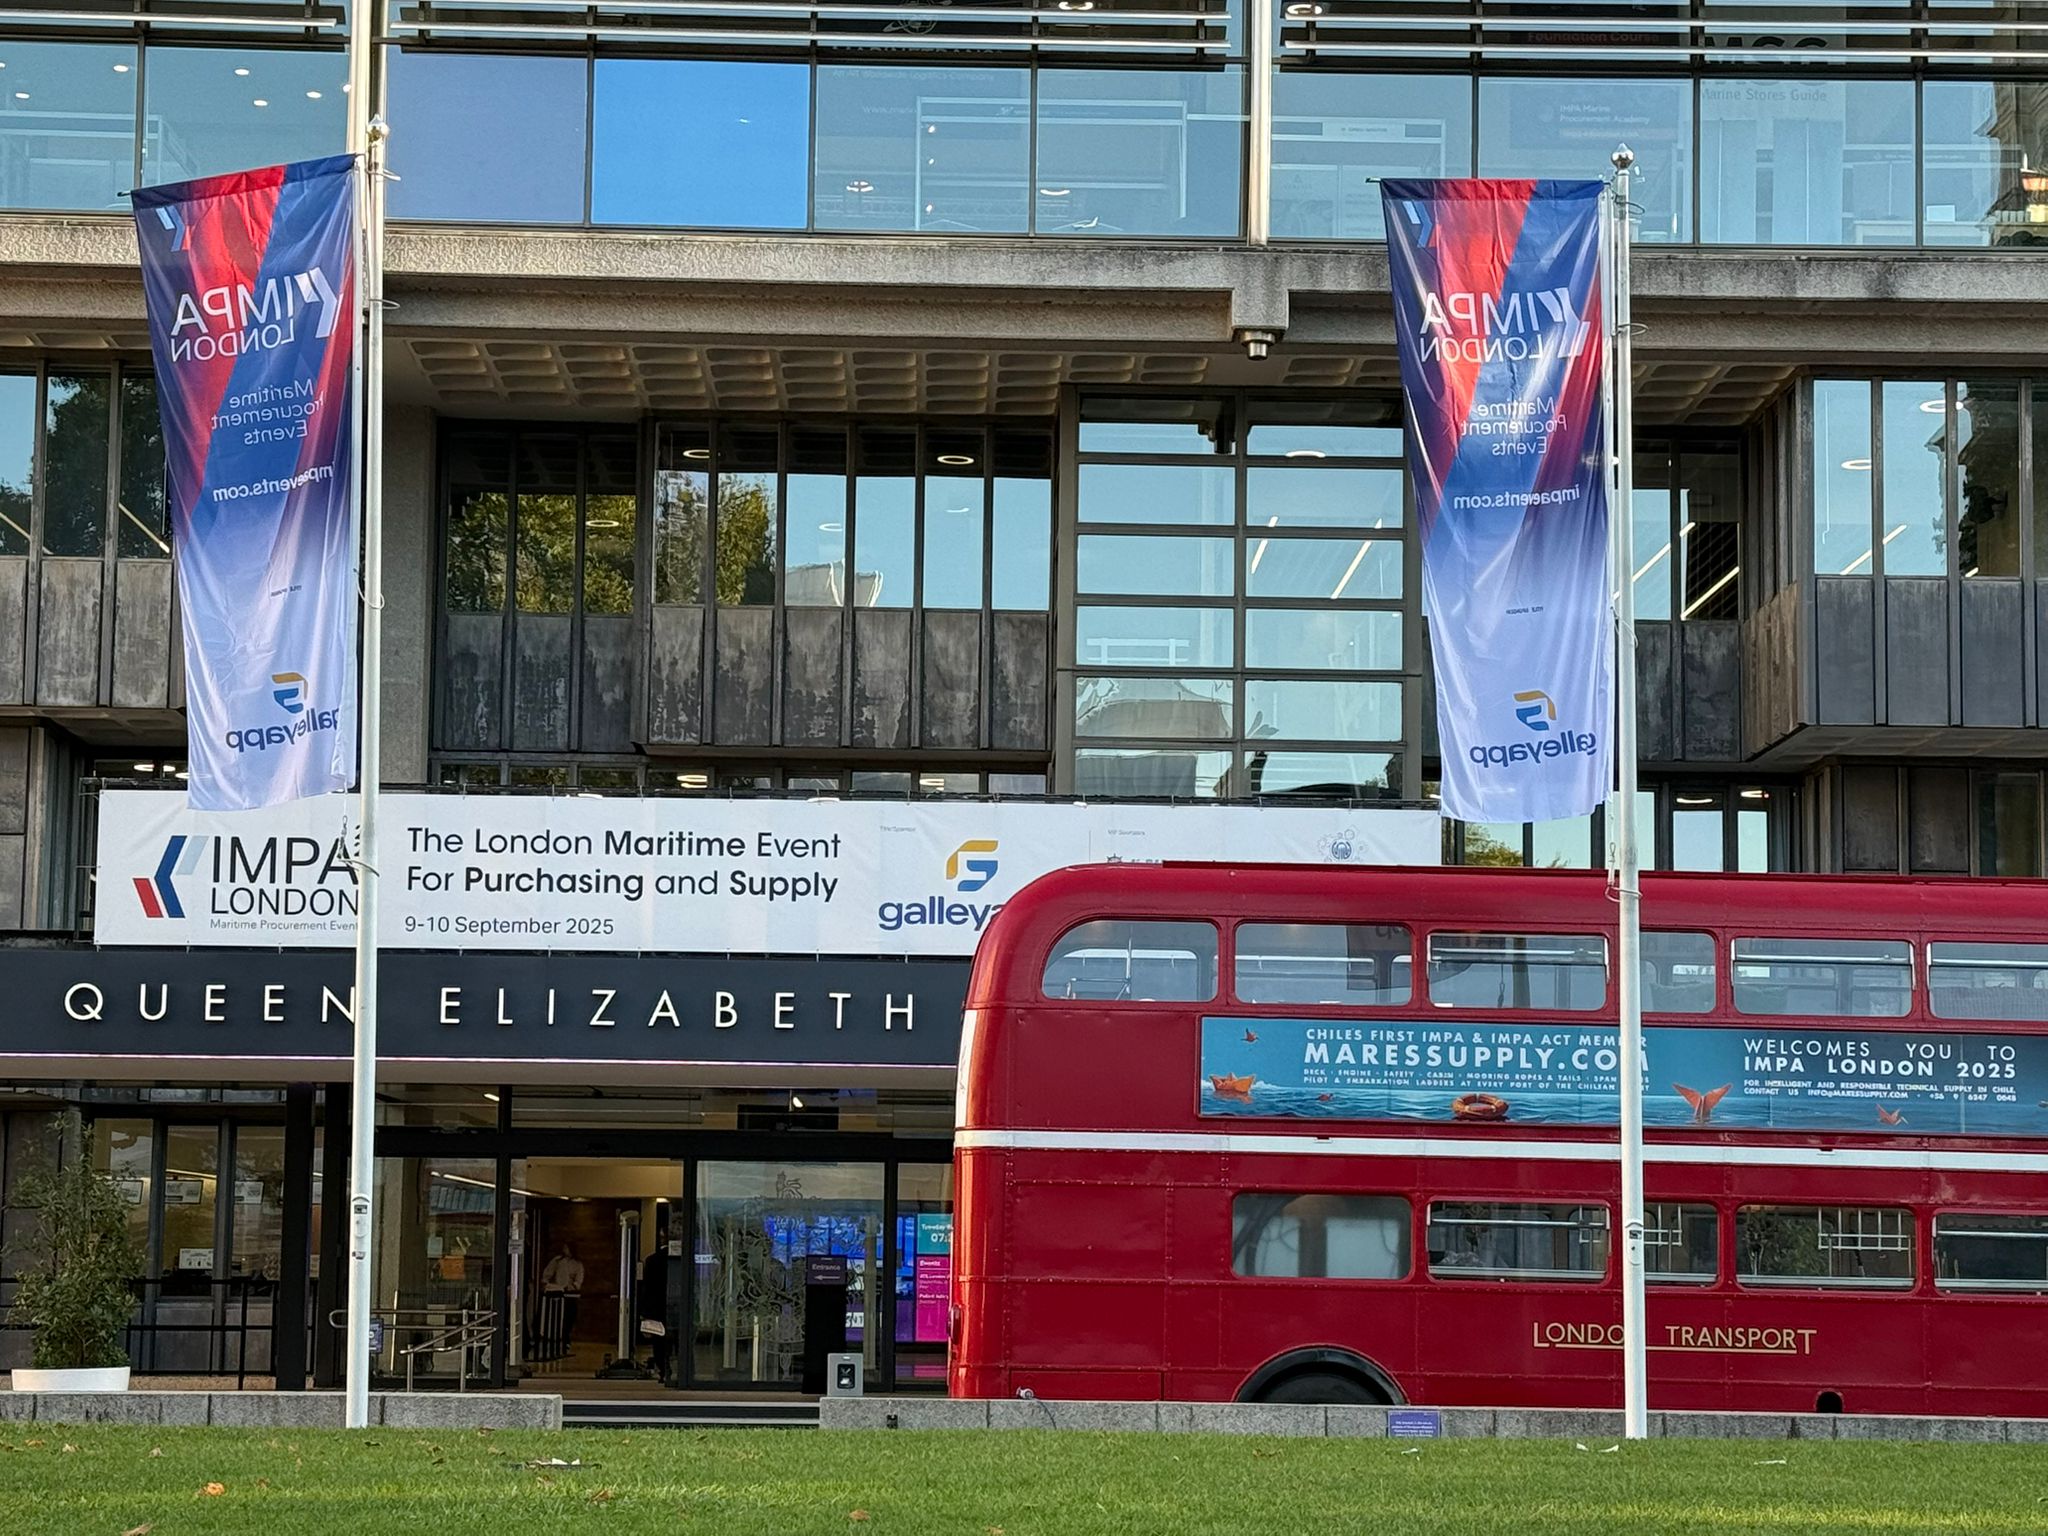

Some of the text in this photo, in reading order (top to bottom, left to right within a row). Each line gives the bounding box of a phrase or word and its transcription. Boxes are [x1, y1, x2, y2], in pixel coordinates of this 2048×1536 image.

[1746, 88, 1785, 101] Stores
[1790, 89, 1827, 101] Guide
[407, 827, 842, 859] The London Maritime Event
[212, 835, 359, 886] IMPA
[407, 865, 839, 903] For Purchasing and Supply
[210, 886, 359, 917] LONDON
[210, 918, 359, 932] Maritime Procurement Event
[404, 915, 615, 937] 9-10 September 2025
[64, 982, 915, 1030] QUEEN ELIZABETH
[1370, 1030, 1415, 1042] FIRST
[1422, 1031, 1465, 1043] IMPA
[1472, 1032, 1484, 1044] &
[1491, 1032, 1534, 1045] IMPA
[1540, 1033, 1572, 1046] ACT
[1578, 1034, 1647, 1047] MEMR
[1743, 1038, 2016, 1061] WELCOMES YOU TO
[1466, 1072, 1510, 1080] MOORING
[1514, 1073, 1543, 1081] ROPES
[1744, 1056, 2016, 1079] IMPA LONDON 2025
[1303, 1076, 1328, 1084] PILOT
[1538, 1081, 1550, 1089] OF
[1743, 1079, 1760, 1087] FOR
[1816, 1081, 1835, 1089] AND
[1943, 1084, 1973, 1093] SUPPLY
[1977, 1085, 1988, 1093] IN
[1743, 1087, 1780, 1095] CONTACT
[1788, 1088, 1799, 1096] US
[1533, 1322, 1818, 1355] LONDO TRANSPORT
